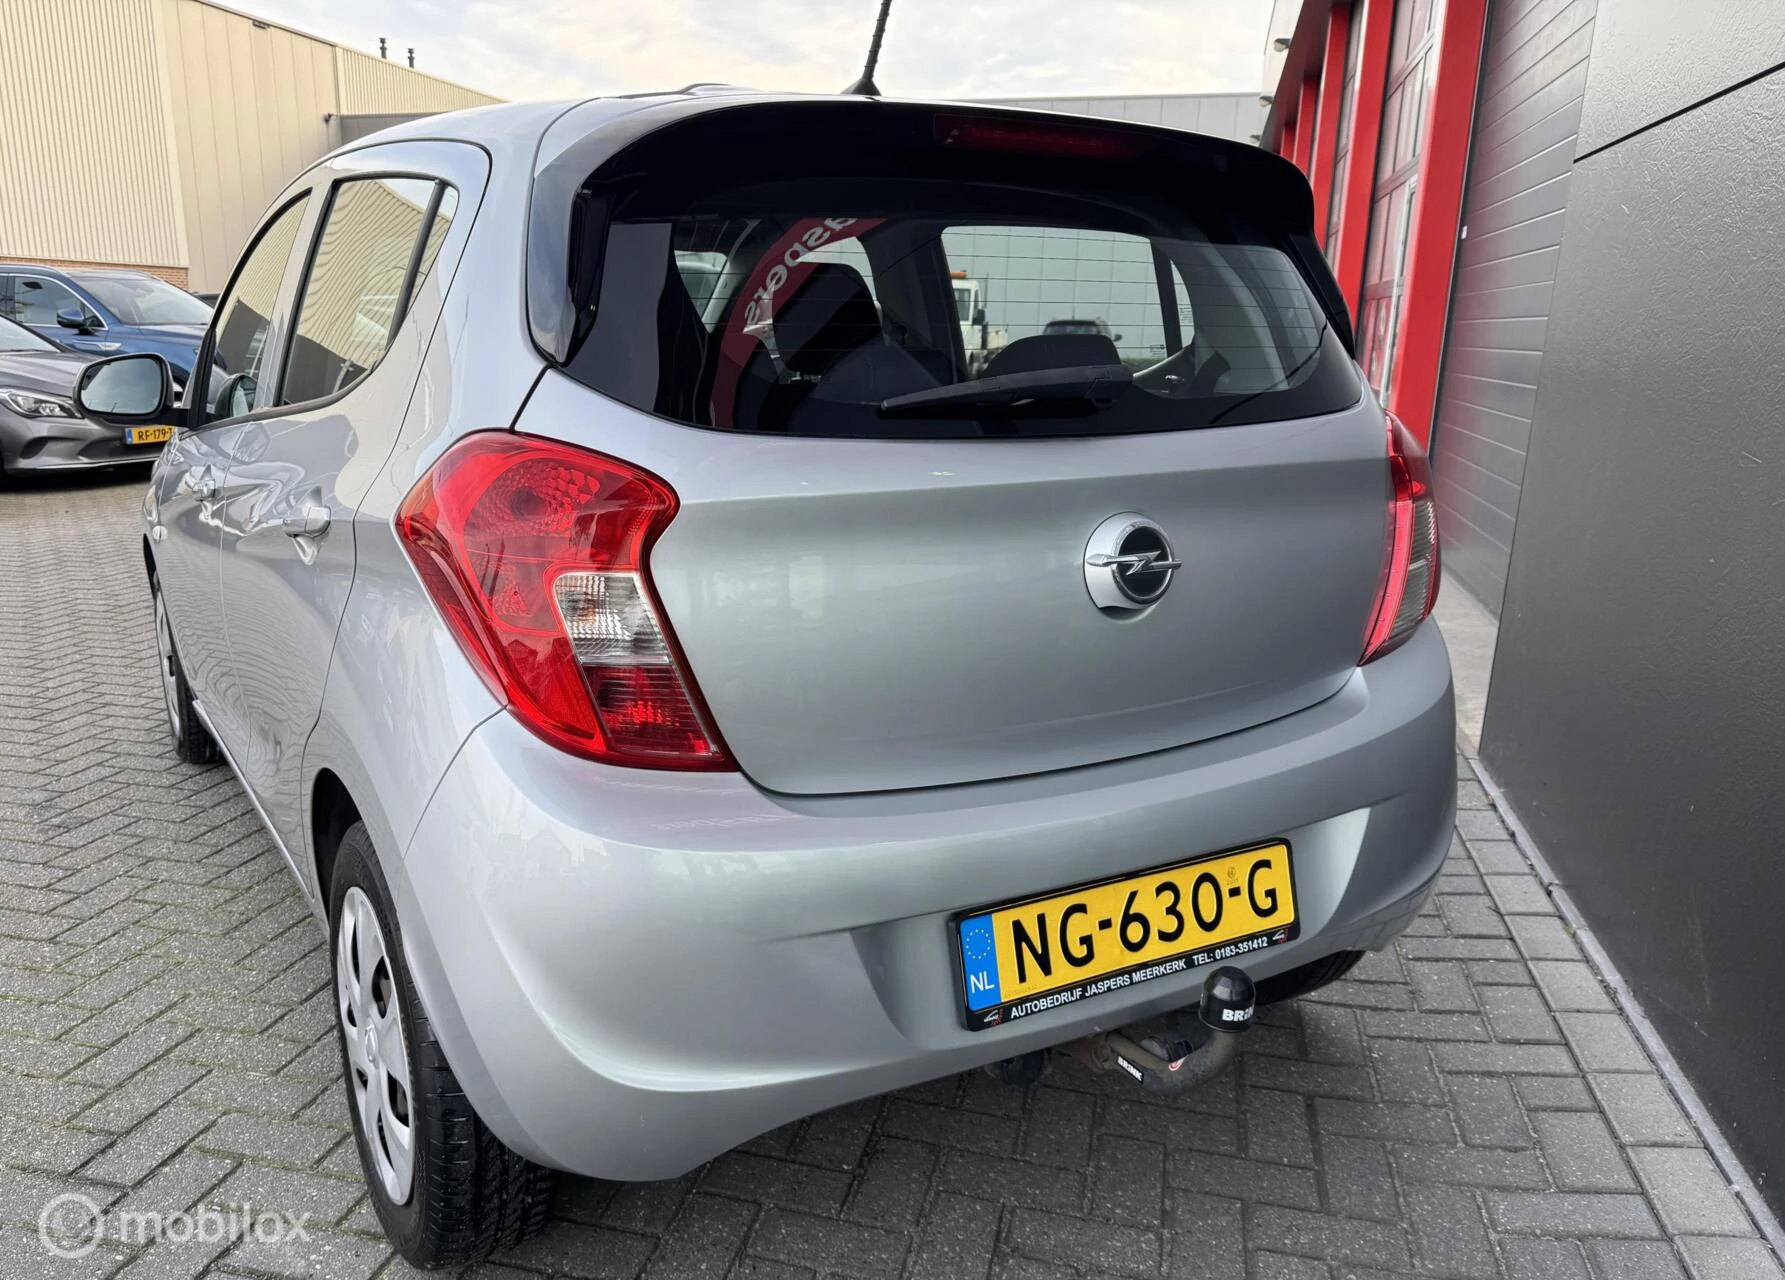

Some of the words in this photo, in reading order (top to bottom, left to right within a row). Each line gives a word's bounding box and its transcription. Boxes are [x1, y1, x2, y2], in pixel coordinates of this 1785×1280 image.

[1012, 858, 1279, 984] NG-630-G
[970, 970, 995, 994] NL
[1010, 988, 1083, 1019] AUTOBEDRIJF
[1085, 974, 1131, 998] JASPERS
[1132, 959, 1187, 983] MEERKERK
[1192, 951, 1214, 966] TEL:
[1215, 937, 1269, 959] 0183-351412
